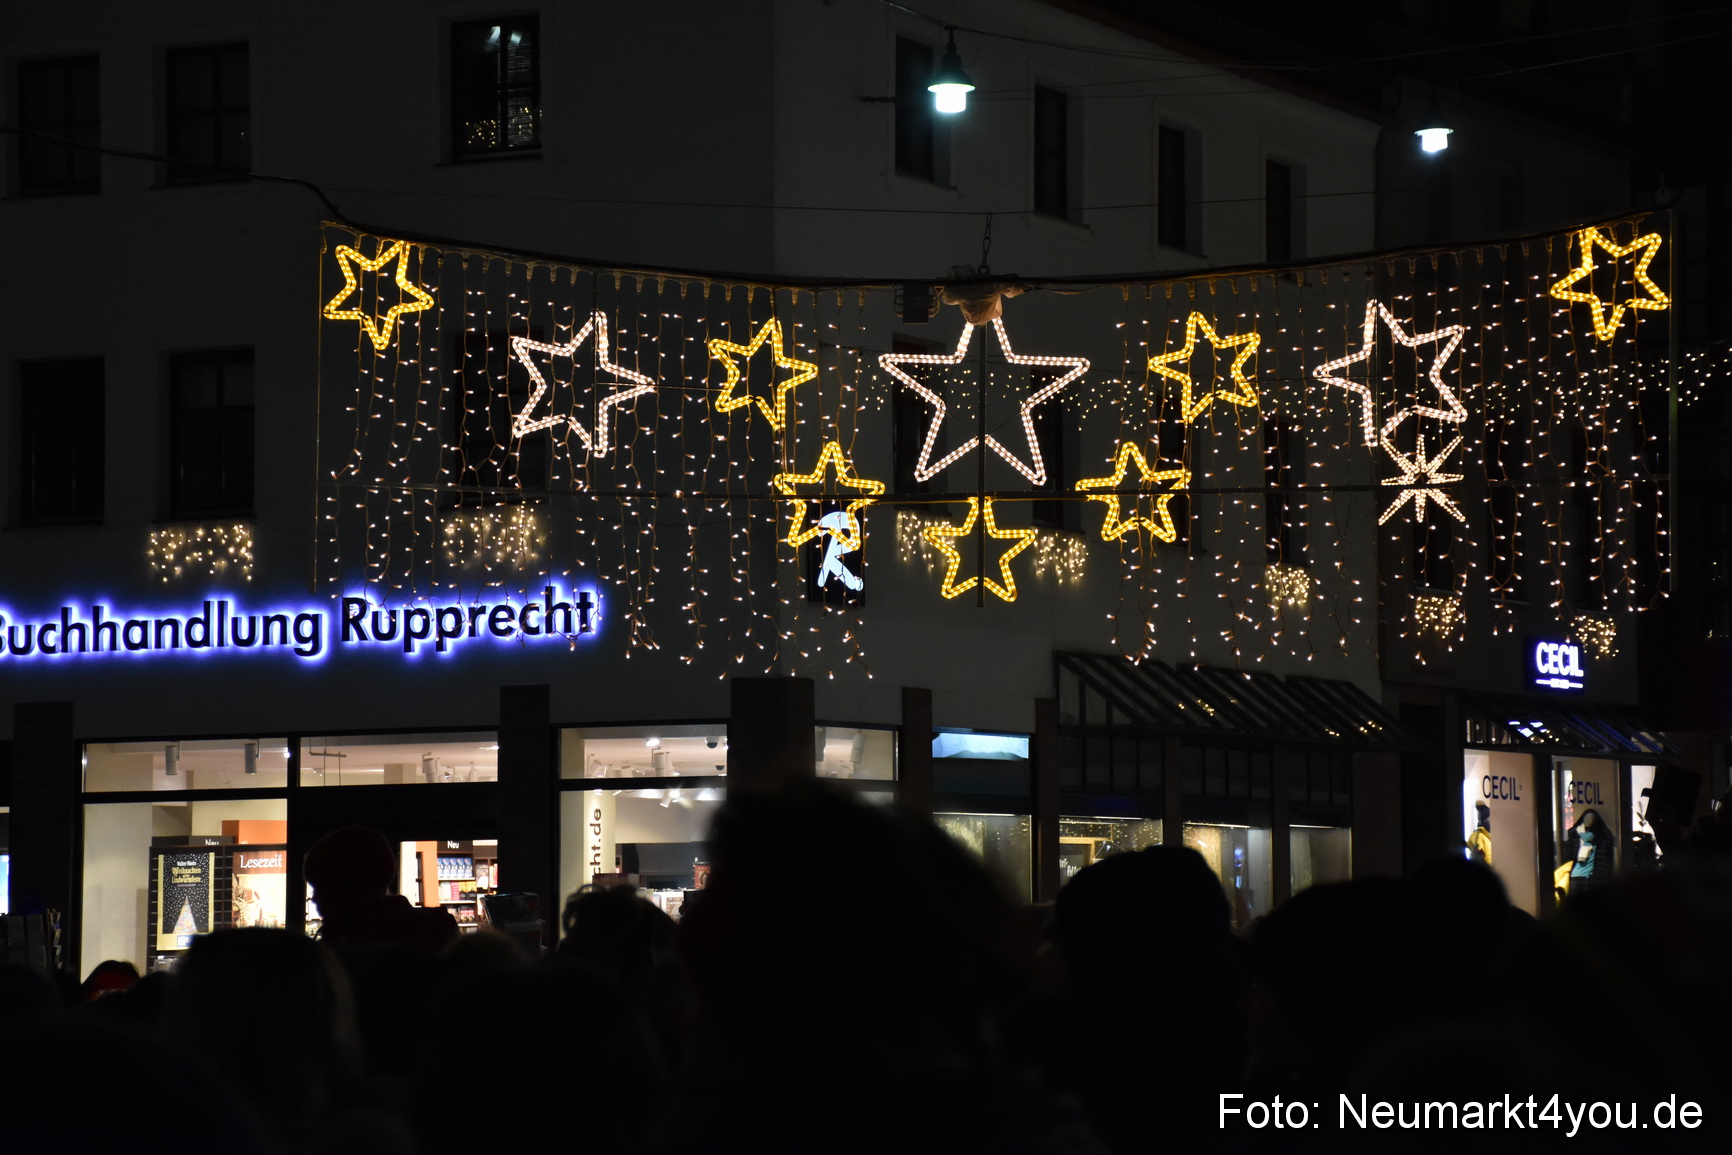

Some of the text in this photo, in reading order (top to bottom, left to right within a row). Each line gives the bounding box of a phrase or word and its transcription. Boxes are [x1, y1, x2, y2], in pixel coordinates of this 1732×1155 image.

[341, 586, 595, 653] Rupprecht
[1535, 641, 1585, 678] CECIL
[1482, 775, 1521, 801] CECIL
[1569, 780, 1604, 806] CECIL
[447, 840, 459, 849] Neu
[240, 854, 282, 868] Lesezeit
